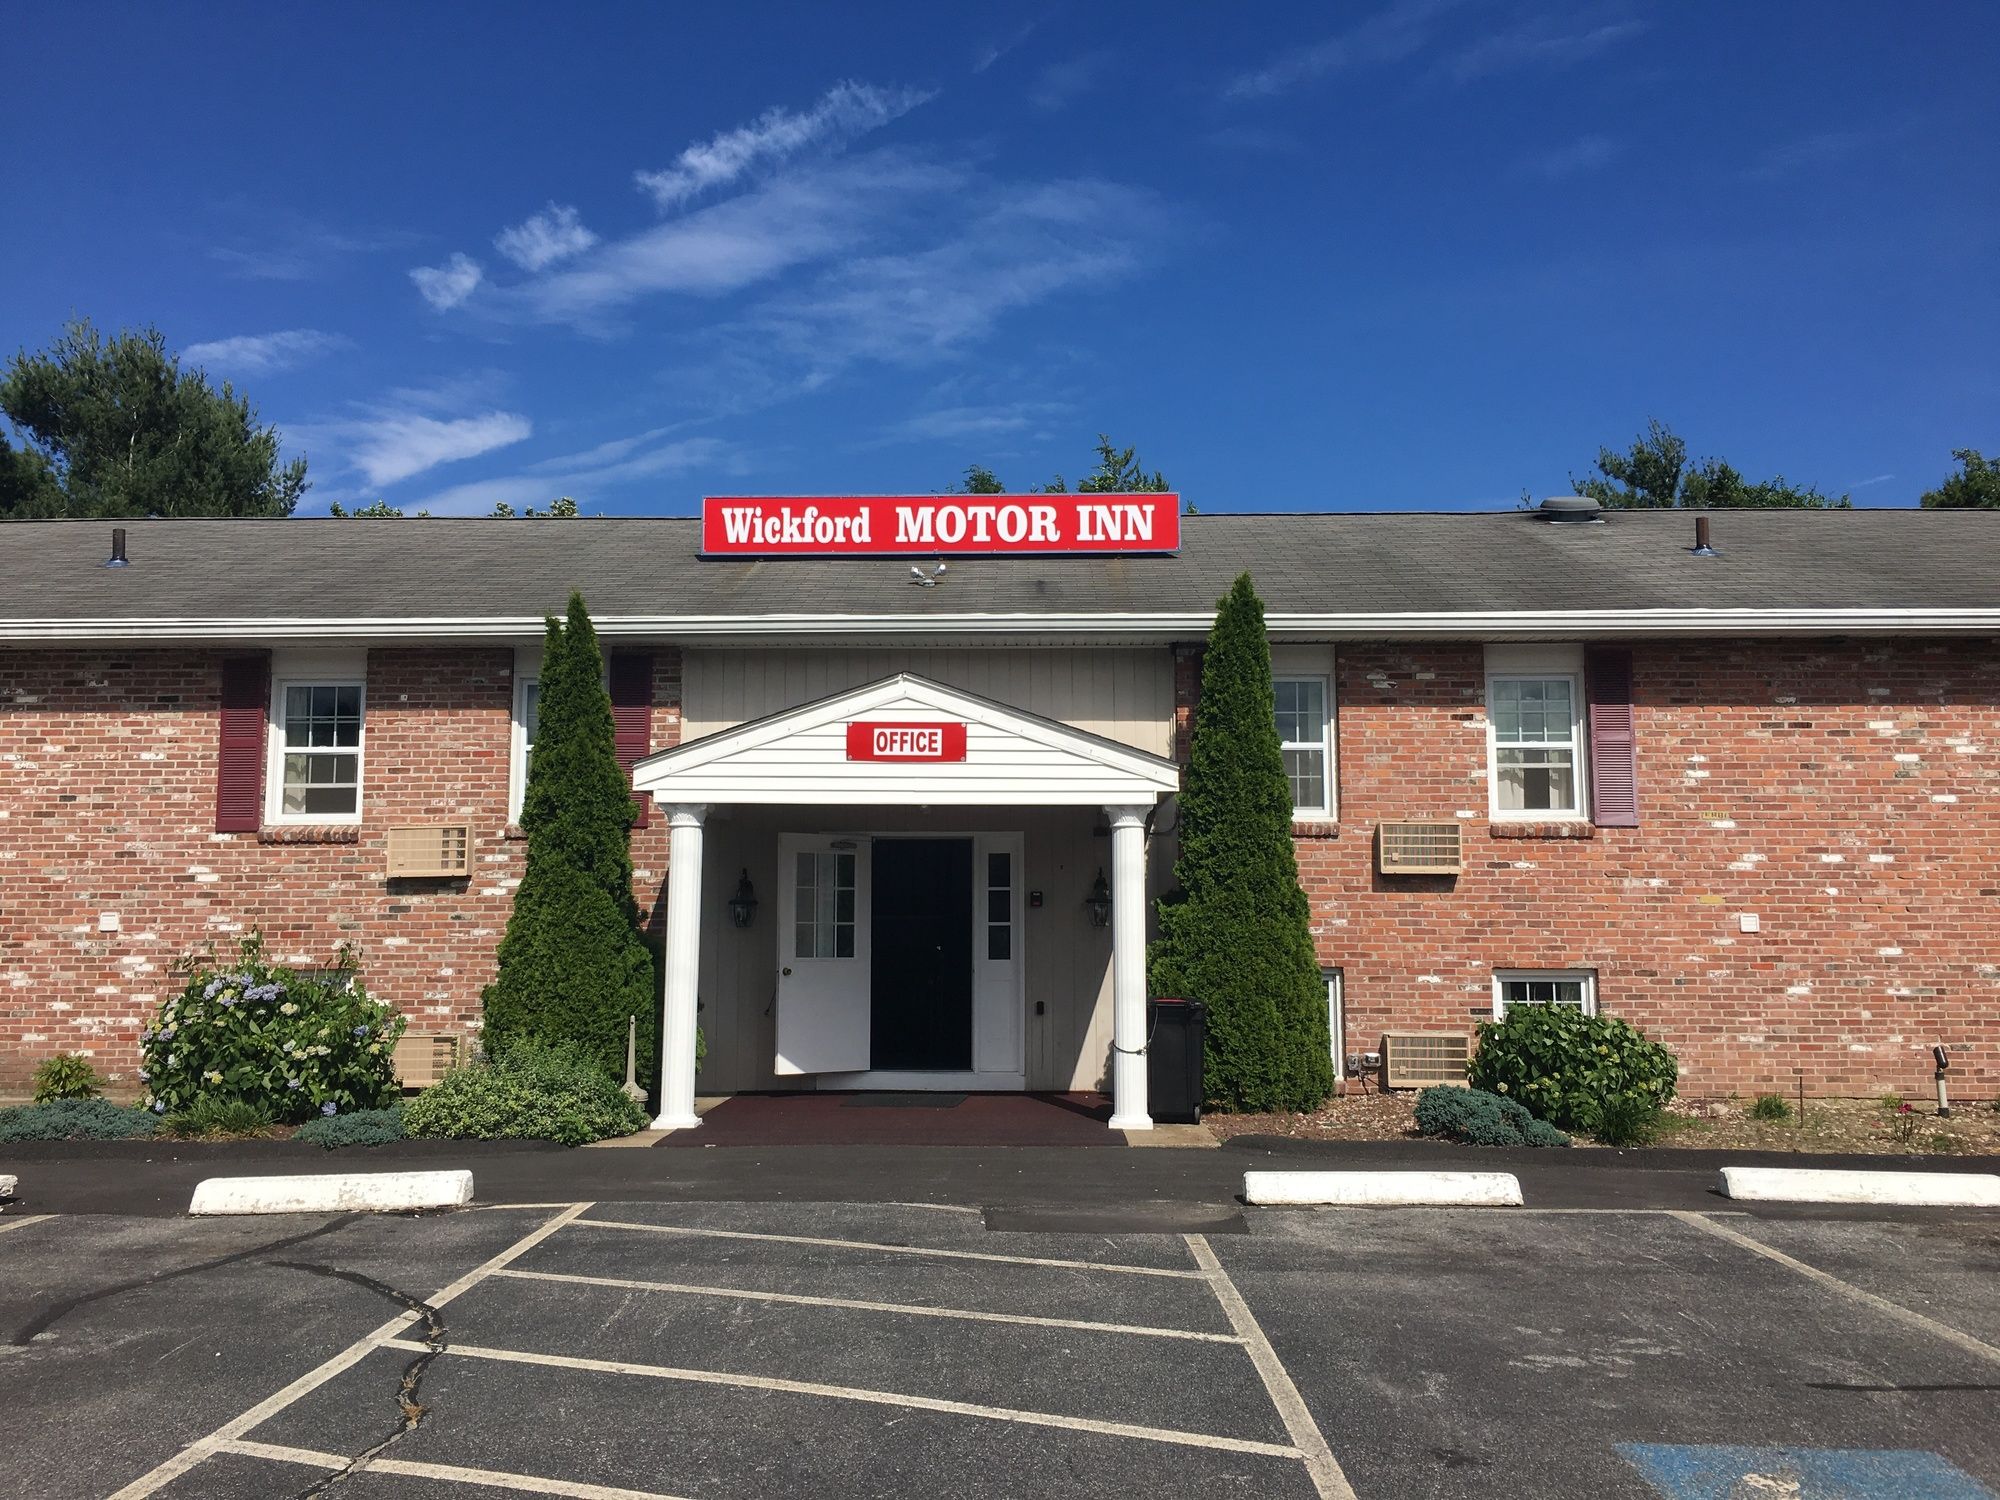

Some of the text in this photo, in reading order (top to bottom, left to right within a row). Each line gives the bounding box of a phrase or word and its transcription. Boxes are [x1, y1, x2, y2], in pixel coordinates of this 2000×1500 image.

[721, 504, 1155, 544] Wickford MOTOR INN
[876, 731, 938, 752] OFFICE
